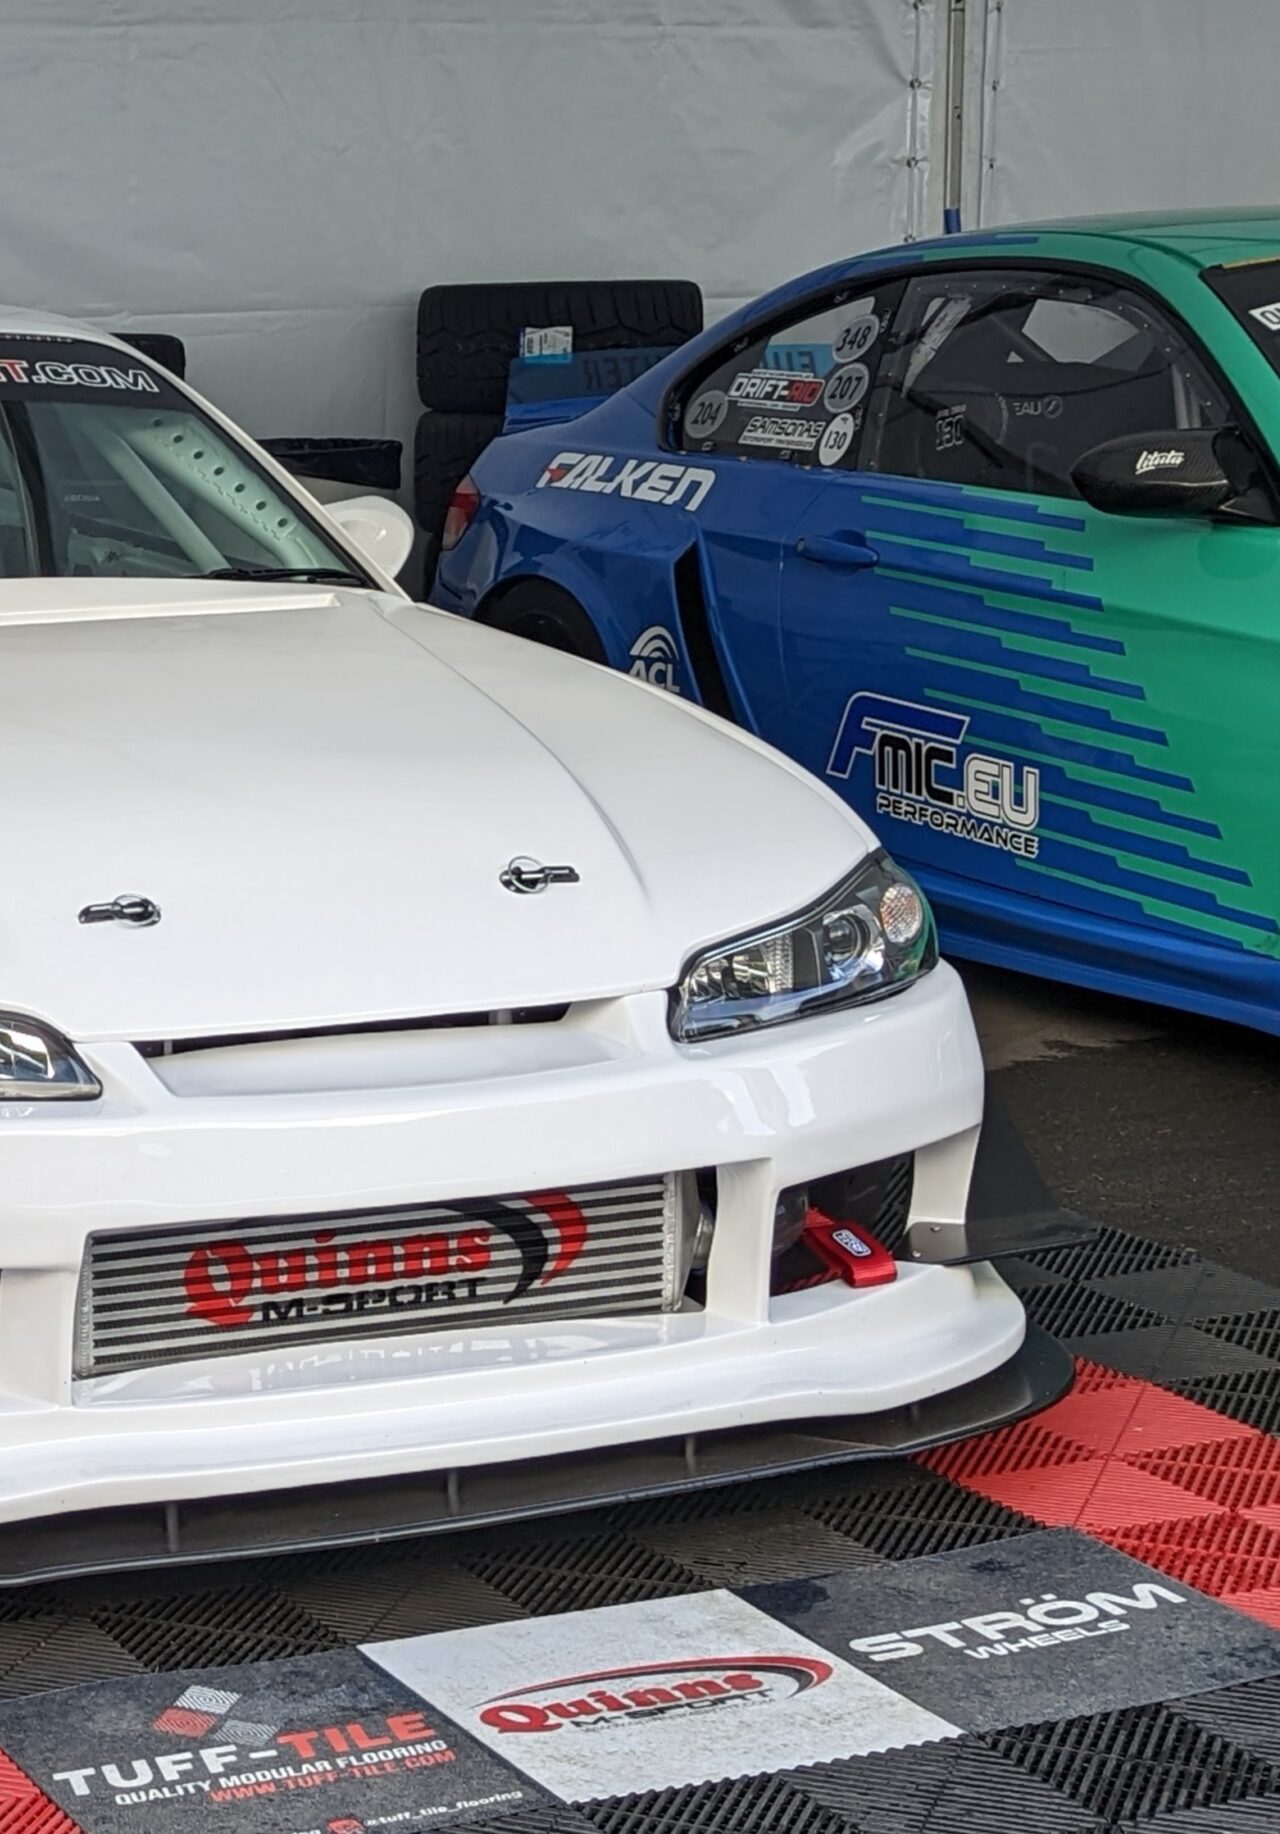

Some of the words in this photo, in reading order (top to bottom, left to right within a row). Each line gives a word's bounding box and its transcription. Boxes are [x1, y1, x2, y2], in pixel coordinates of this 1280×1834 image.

[836, 325, 871, 351] 348
[827, 375, 864, 400] 207
[691, 403, 722, 425] 204
[745, 416, 824, 439] SAMSONAS
[825, 430, 847, 450] 130
[535, 452, 716, 512] FALKEN
[629, 660, 680, 693] ACL
[876, 795, 1039, 858] PERFORMANCE
[183, 1210, 493, 1326] Quinns
[262, 1277, 487, 1321] M-SPORT
[849, 1583, 1187, 1662] STRÖM
[963, 1620, 1131, 1660] WHEELS
[480, 1673, 763, 1734] Quinns
[570, 1689, 774, 1728] M-SPORT
[53, 1712, 436, 1797] TUFF-TILE
[115, 1780, 211, 1805] QUALITY
[219, 1758, 332, 1789] MODULAR
[336, 1740, 448, 1769] FLOORING
[211, 1750, 456, 1803] WWW.TUFF-TILE.COM
